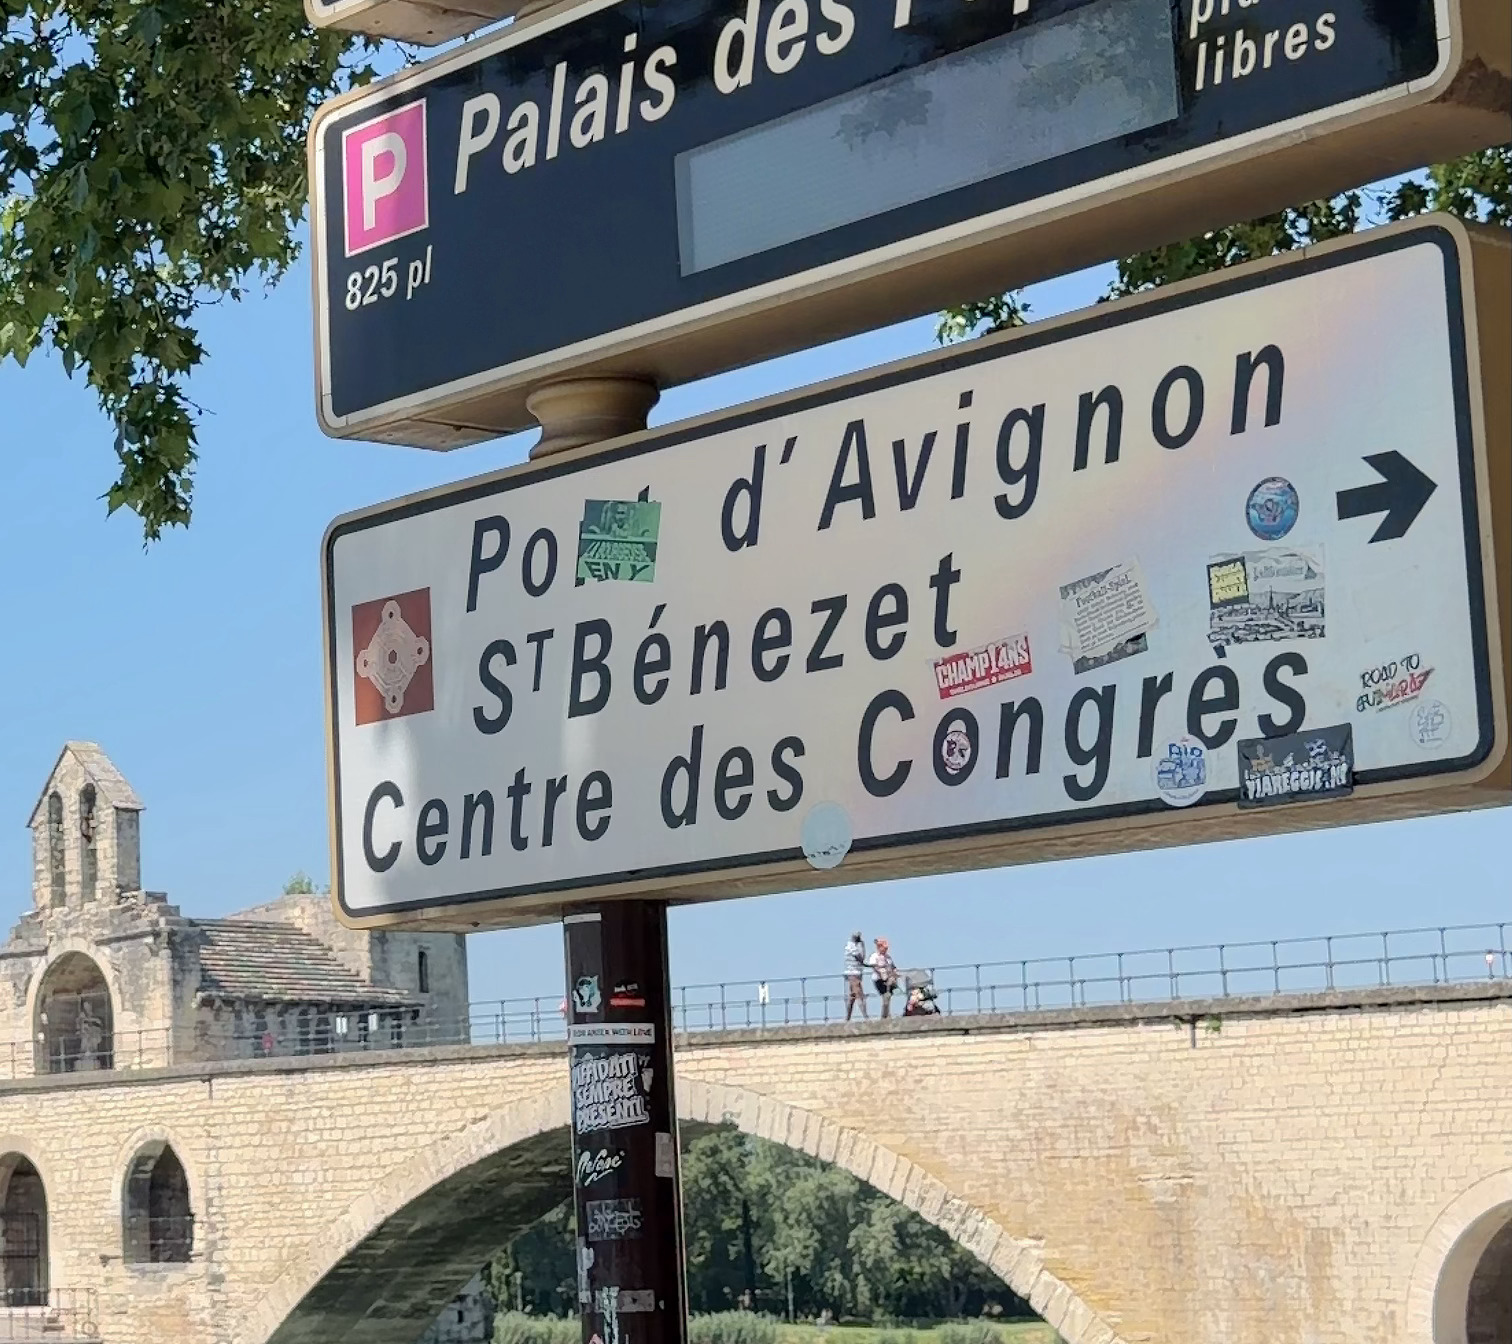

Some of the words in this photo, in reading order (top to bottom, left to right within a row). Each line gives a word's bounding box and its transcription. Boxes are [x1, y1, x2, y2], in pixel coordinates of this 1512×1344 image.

[454, 32, 678, 195] Palais
[1194, 11, 1337, 91] libres
[361, 130, 408, 231] P
[344, 257, 398, 312] 825
[407, 245, 433, 300] pl
[465, 484, 652, 613] Po
[720, 344, 1285, 553] d'Avignon
[567, 552, 962, 720] Bénezet
[362, 765, 613, 873] Centre
[660, 723, 806, 830] des
[856, 643, 1309, 802] Congrès
